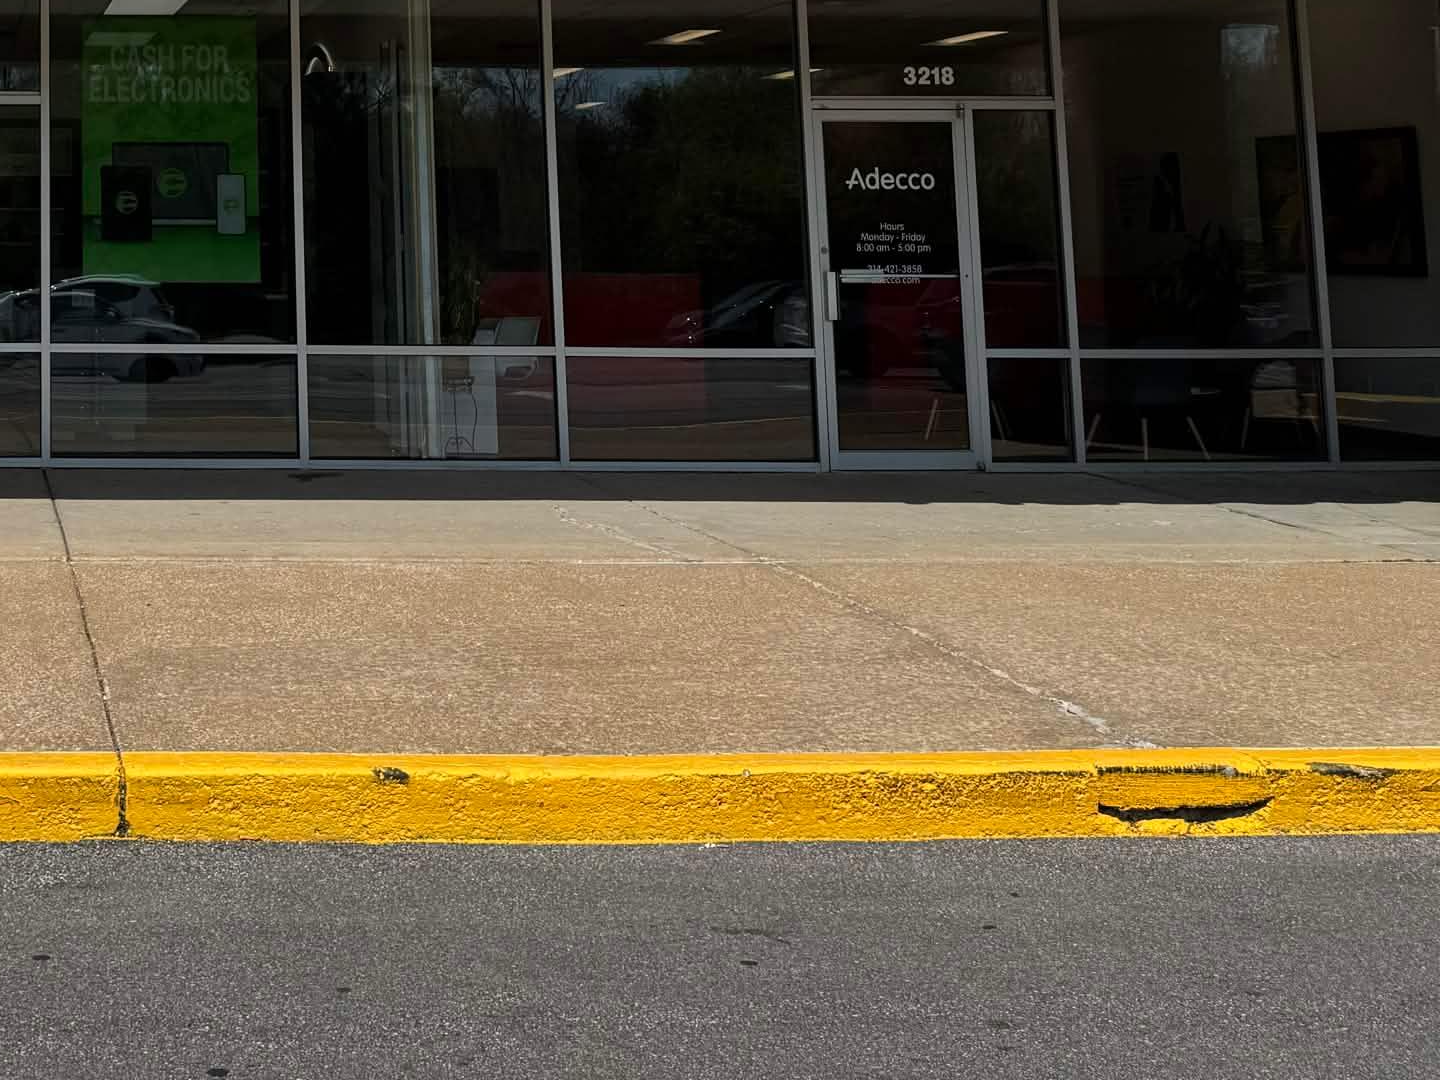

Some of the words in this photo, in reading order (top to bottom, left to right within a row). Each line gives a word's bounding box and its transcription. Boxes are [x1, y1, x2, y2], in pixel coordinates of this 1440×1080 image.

[110, 44, 176, 72] CASH
[181, 44, 230, 72] FOR
[903, 66, 955, 86] 3218
[88, 74, 251, 104] ELECTRONICS
[845, 166, 936, 191] Adecco
[879, 222, 905, 231] Hours
[860, 232, 895, 244] Monday
[901, 232, 926, 244] Friday
[856, 243, 875, 252] 8:00
[876, 244, 891, 252] am
[898, 243, 916, 252] 5:00
[917, 244, 932, 254] pm
